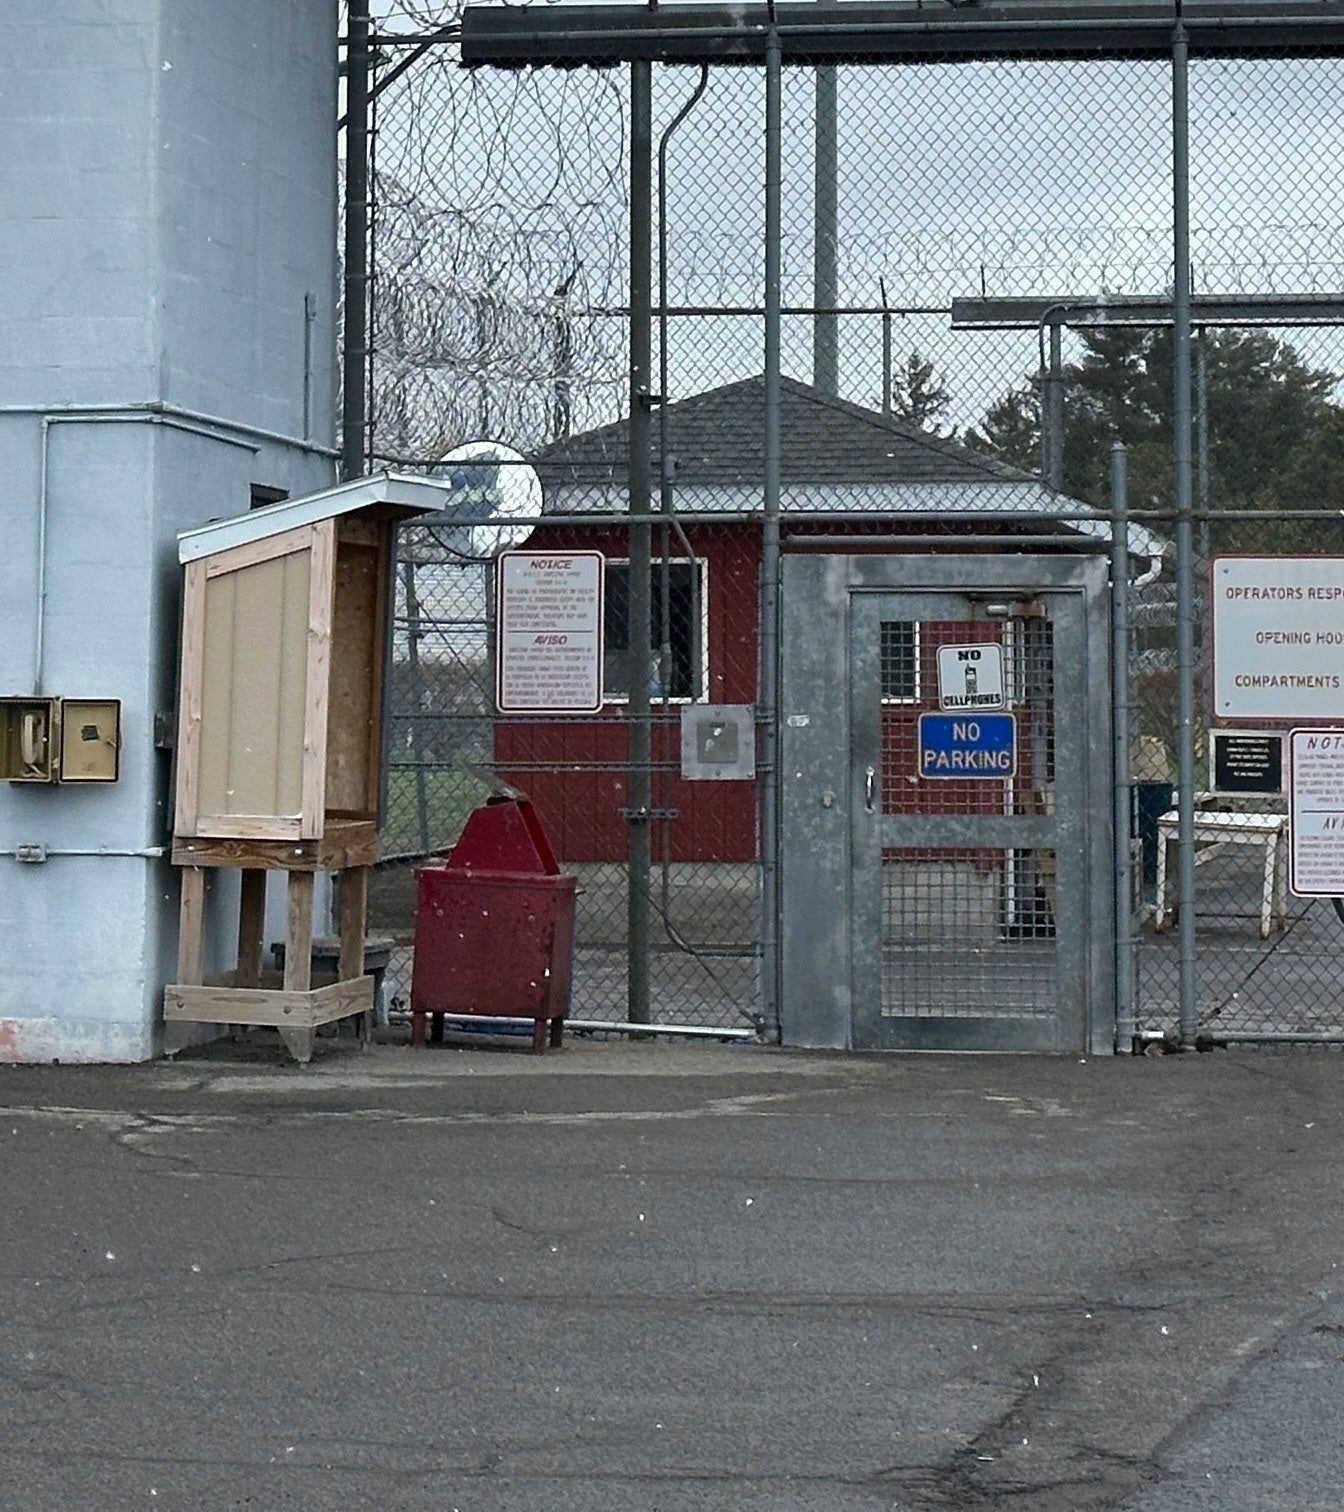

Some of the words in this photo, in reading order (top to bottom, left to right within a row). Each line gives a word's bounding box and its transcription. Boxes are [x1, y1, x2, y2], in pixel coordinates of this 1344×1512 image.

[530, 560, 573, 569] NOTICE
[1226, 587, 1303, 600] OPERATORS
[534, 635, 568, 645] AVISO
[1256, 631, 1311, 645] OPENING
[958, 650, 981, 661] NO
[1235, 674, 1340, 688] COMPARTMENTS
[953, 722, 981, 741] NO
[924, 750, 1010, 768] PARKING
